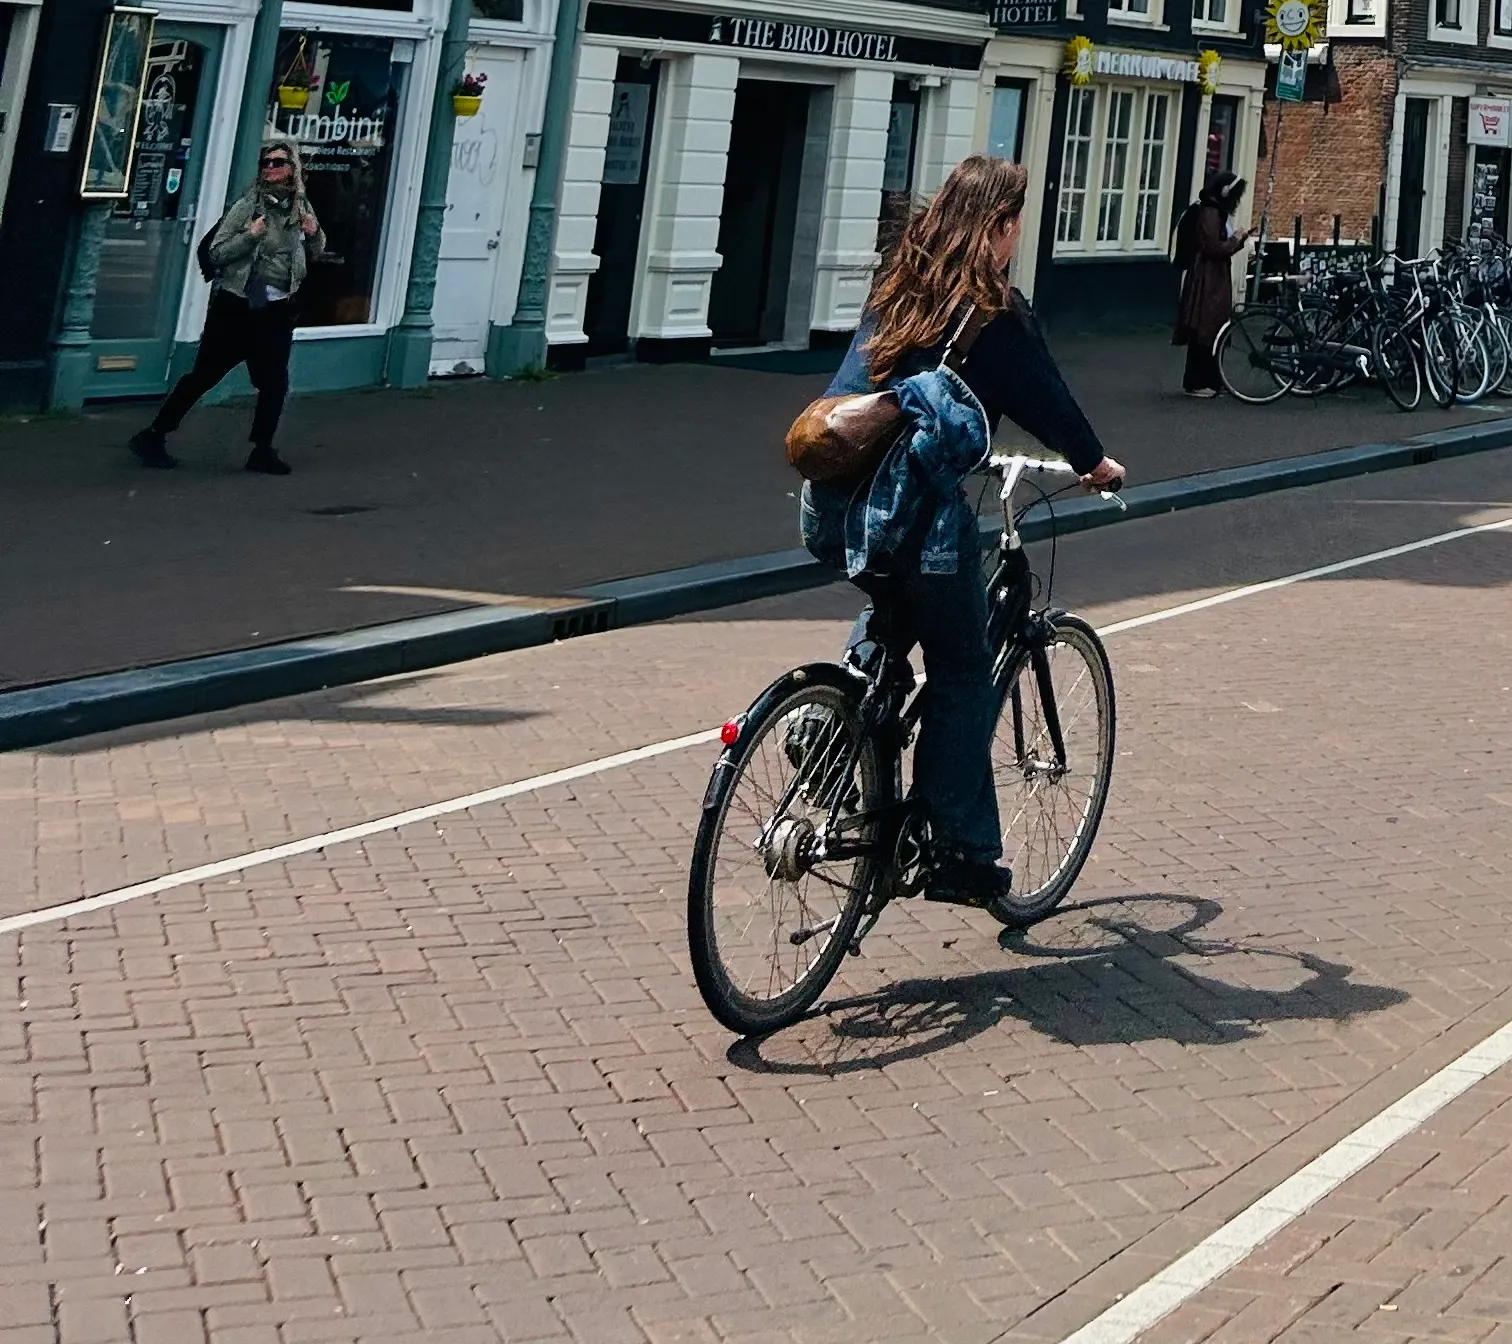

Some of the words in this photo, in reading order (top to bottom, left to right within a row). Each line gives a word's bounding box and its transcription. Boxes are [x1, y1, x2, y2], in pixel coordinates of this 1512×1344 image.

[993, 5, 1058, 24] HOTEL
[730, 18, 776, 48] THE
[779, 23, 830, 54] BIRD
[832, 31, 899, 62] HOTEL
[268, 101, 384, 141] Lumbini
